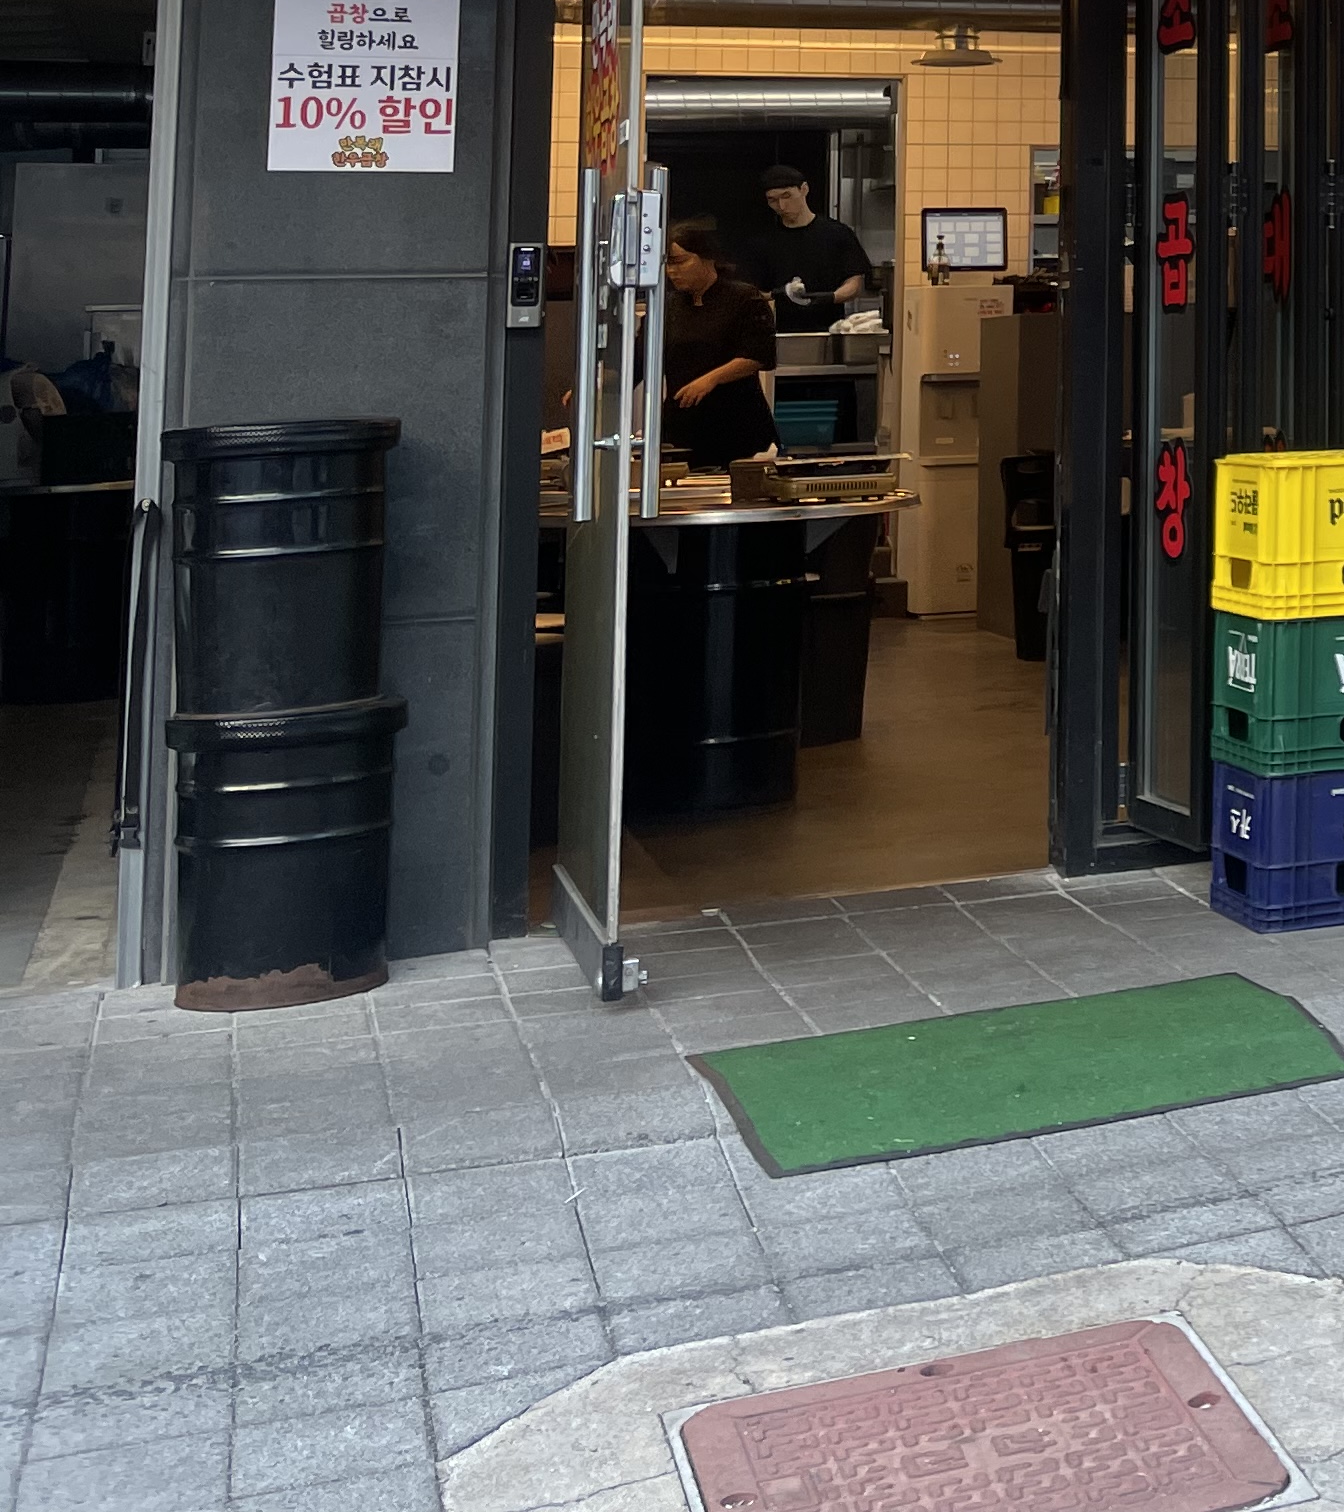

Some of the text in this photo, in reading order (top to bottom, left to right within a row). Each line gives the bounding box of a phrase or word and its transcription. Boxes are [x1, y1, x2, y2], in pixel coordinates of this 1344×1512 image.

[327, 3, 412, 24] 곱창으로
[318, 29, 419, 51] 힐링하세요
[278, 62, 452, 92] 수험표 지참시
[275, 95, 453, 134] 10% 할인
[339, 136, 384, 152] 만복래
[331, 151, 389, 168] 한우곱창
[1230, 807, 1253, 841] 카스
